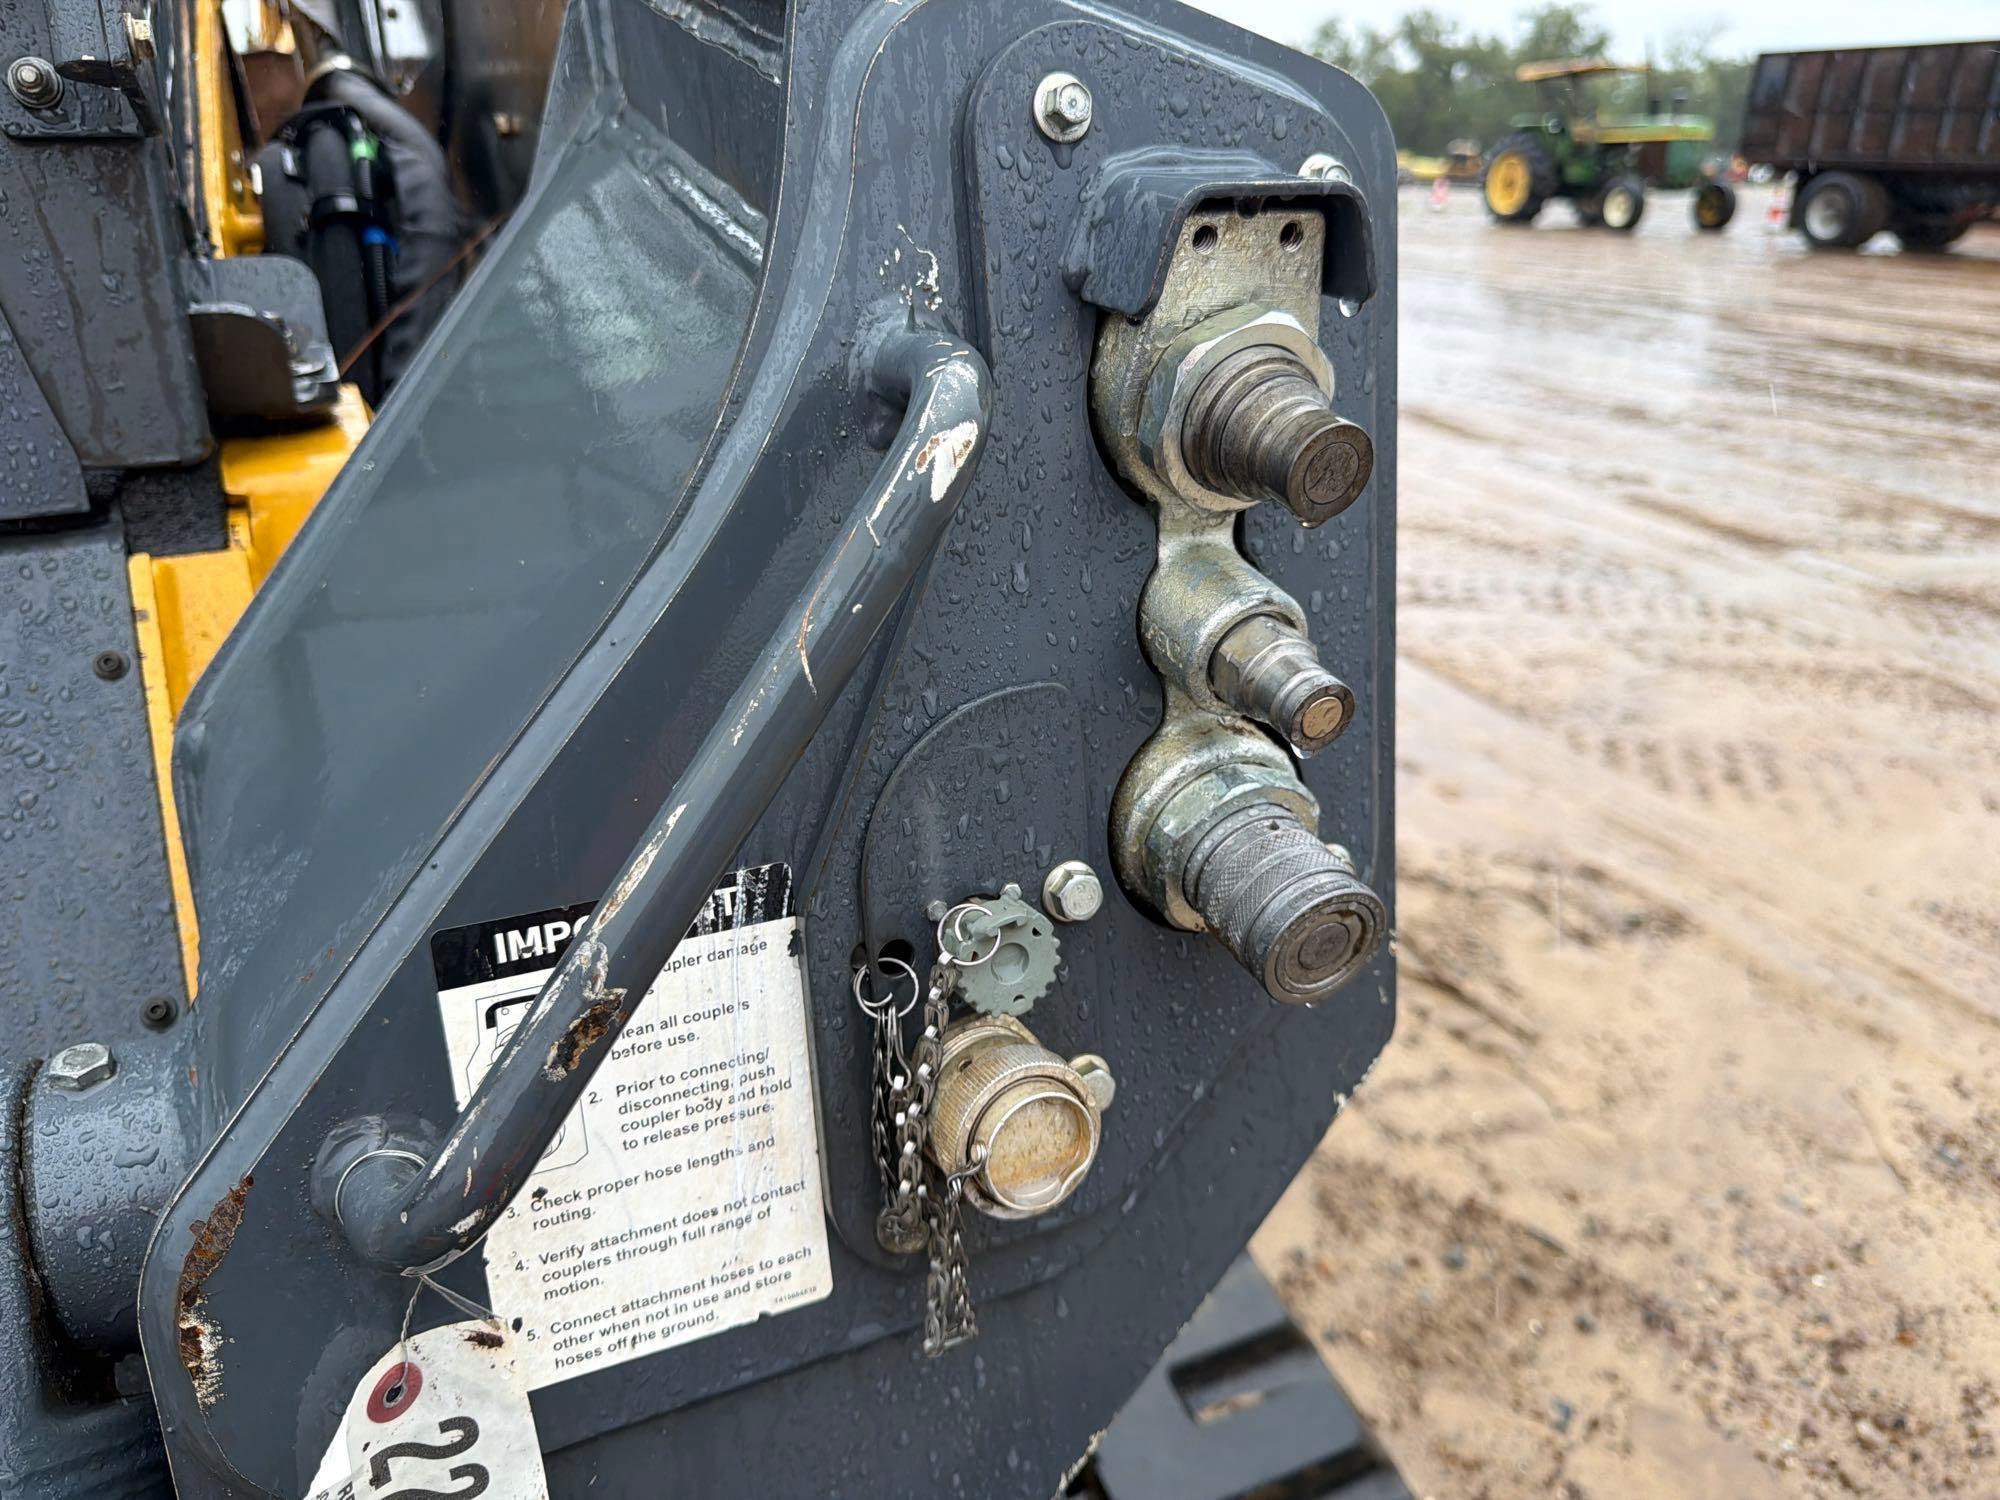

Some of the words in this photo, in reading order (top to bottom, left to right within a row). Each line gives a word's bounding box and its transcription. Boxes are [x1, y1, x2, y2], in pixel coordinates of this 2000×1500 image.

[660, 1015, 678, 1030] all
[683, 1000, 750, 1024] couples
[610, 1039, 662, 1061] before
[667, 1031, 700, 1047] use.
[588, 1090, 603, 1105] 2.
[616, 1077, 656, 1097] Prior
[659, 1074, 676, 1087] to
[680, 1047, 770, 1081] connecting/
[618, 1078, 734, 1115] disconnecting,
[739, 1065, 776, 1087] push
[620, 1108, 681, 1133] coupler
[685, 1096, 724, 1117] body
[728, 1086, 756, 1105] and
[760, 1077, 793, 1096] hold
[622, 1138, 638, 1151] to
[643, 1122, 699, 1146] release
[704, 1102, 775, 1132] pressure.
[506, 1206, 521, 1219] 3.
[530, 1190, 583, 1213] Check
[587, 1175, 640, 1200] proper
[644, 1163, 683, 1182] hose
[687, 1147, 744, 1170] lengths
[748, 1135, 776, 1152] and
[533, 1206, 597, 1231] routing.
[539, 1244, 586, 1265] Verify
[590, 1217, 678, 1252] attachment
[682, 1206, 719, 1225] does
[723, 1197, 749, 1213] not
[751, 1179, 806, 1205] contact
[542, 1255, 612, 1283] couplers
[616, 1235, 678, 1262] through
[682, 1225, 706, 1243] full
[711, 1213, 752, 1235] range
[757, 1205, 772, 1220] of
[526, 1329, 541, 1342] 5.
[550, 1305, 617, 1335] Connect
[621, 1278, 706, 1314] attachment
[710, 1264, 755, 1287] hoses
[759, 1259, 774, 1271] to
[778, 1246, 812, 1265] each
[544, 1276, 605, 1301] motion.
[553, 1331, 595, 1352] other
[599, 1317, 640, 1338] when
[645, 1307, 671, 1324] not
[674, 1302, 688, 1315] in
[692, 1294, 719, 1309] use
[724, 1282, 751, 1299] and
[755, 1270, 792, 1289] store
[555, 1346, 602, 1370] hoses
[607, 1335, 628, 1353] off
[631, 1330, 656, 1348] the
[661, 1310, 720, 1338] ground.
